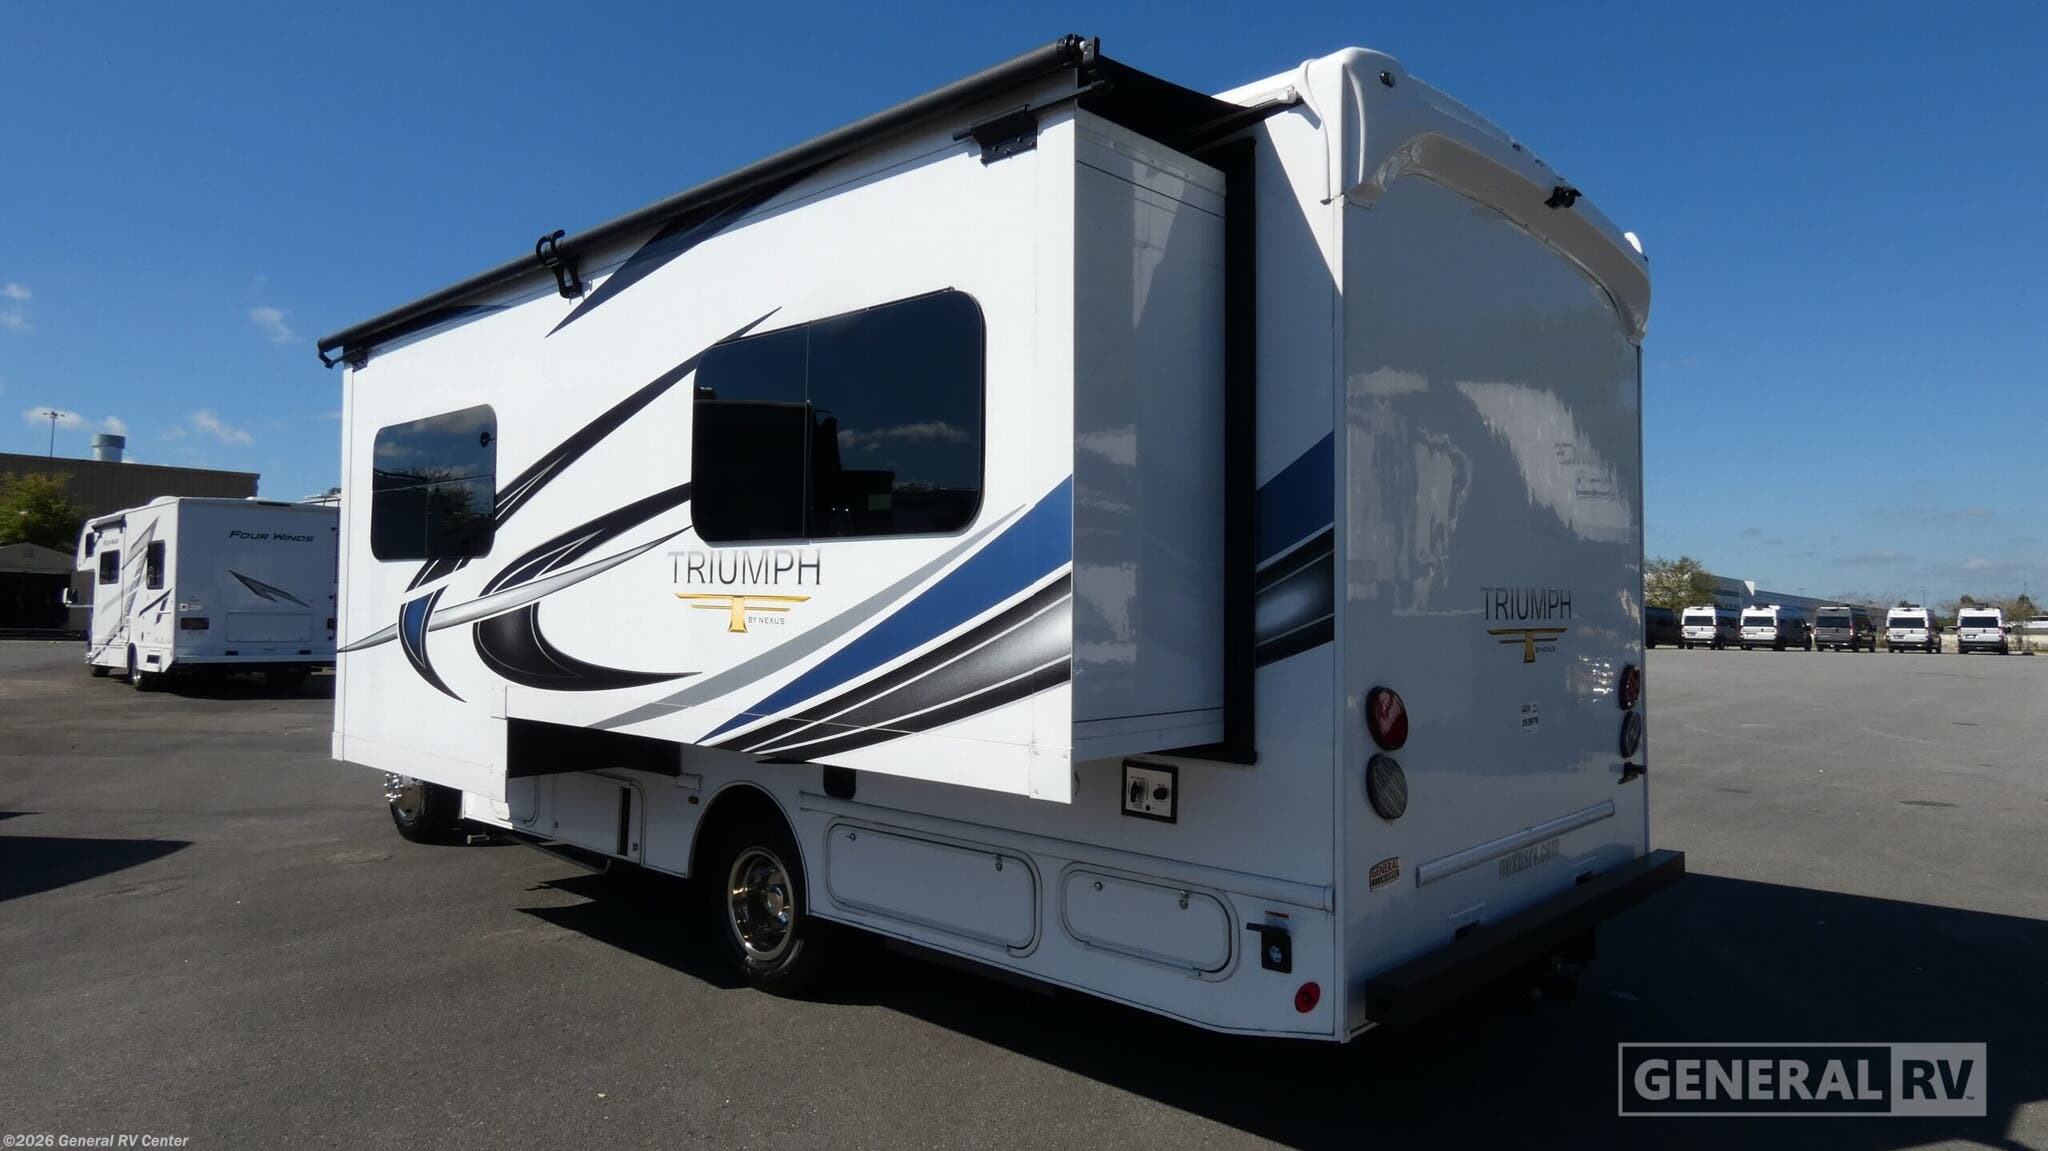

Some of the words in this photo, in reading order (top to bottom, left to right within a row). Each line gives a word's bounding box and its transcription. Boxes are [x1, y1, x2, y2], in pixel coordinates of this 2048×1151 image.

[667, 548, 822, 586] TRIUMPH
[748, 616, 757, 624] BY
[759, 616, 785, 625] NEXUS
[1480, 587, 1572, 621] TRIUMPH
